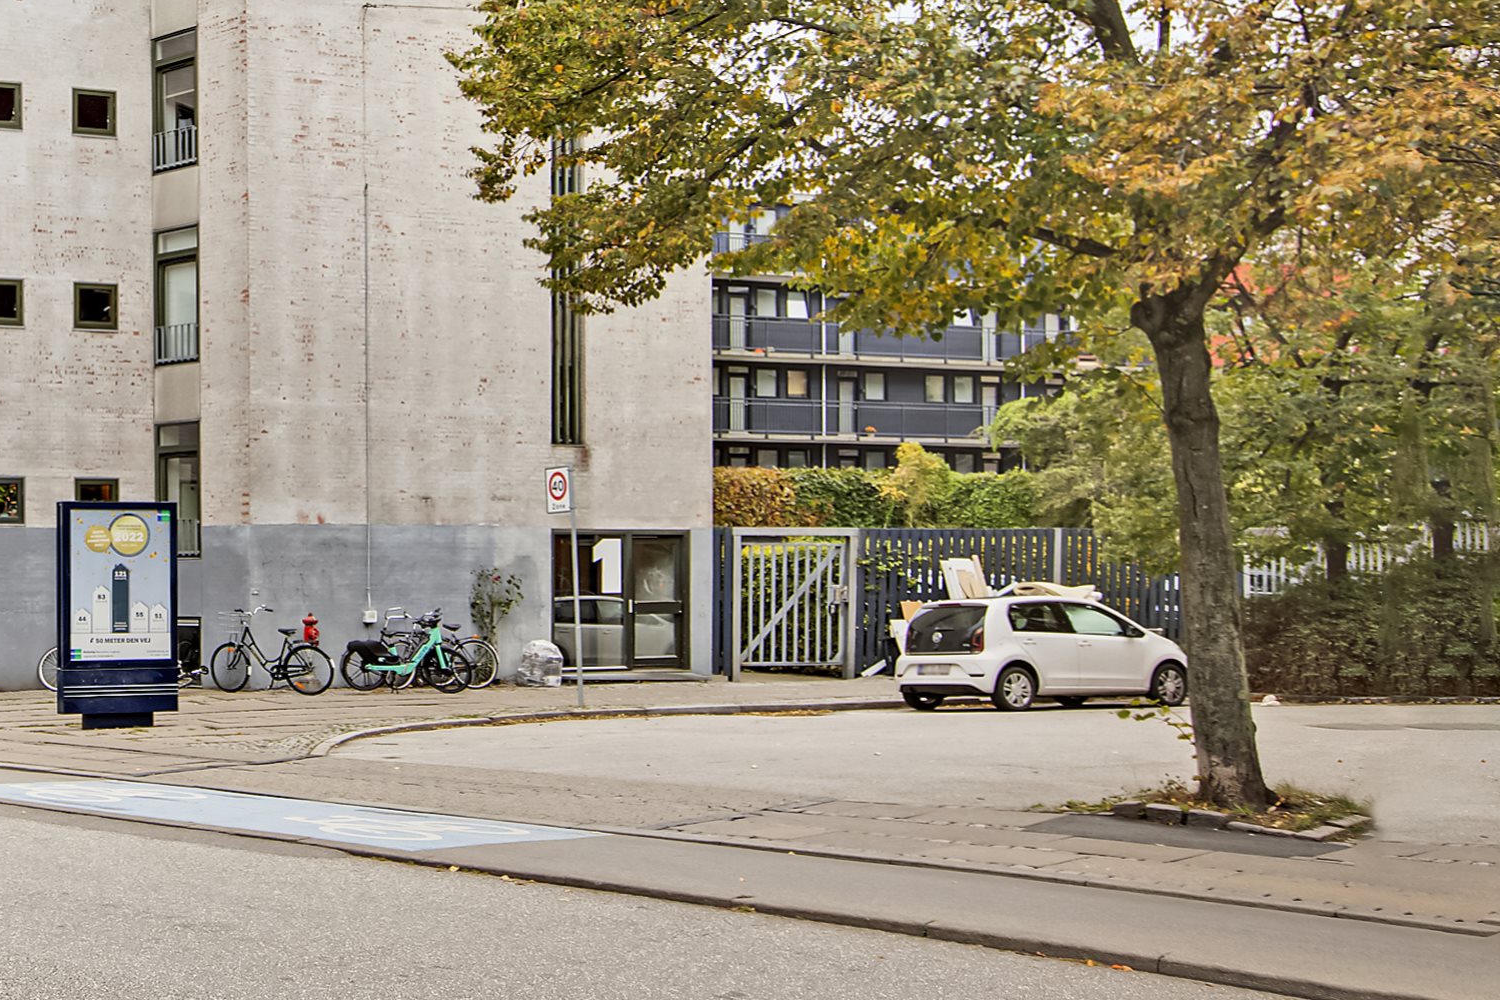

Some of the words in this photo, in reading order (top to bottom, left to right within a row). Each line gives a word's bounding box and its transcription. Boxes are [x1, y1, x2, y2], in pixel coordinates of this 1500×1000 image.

[552, 480, 563, 492] 40
[113, 532, 144, 543] 2022
[592, 538, 622, 593] 1
